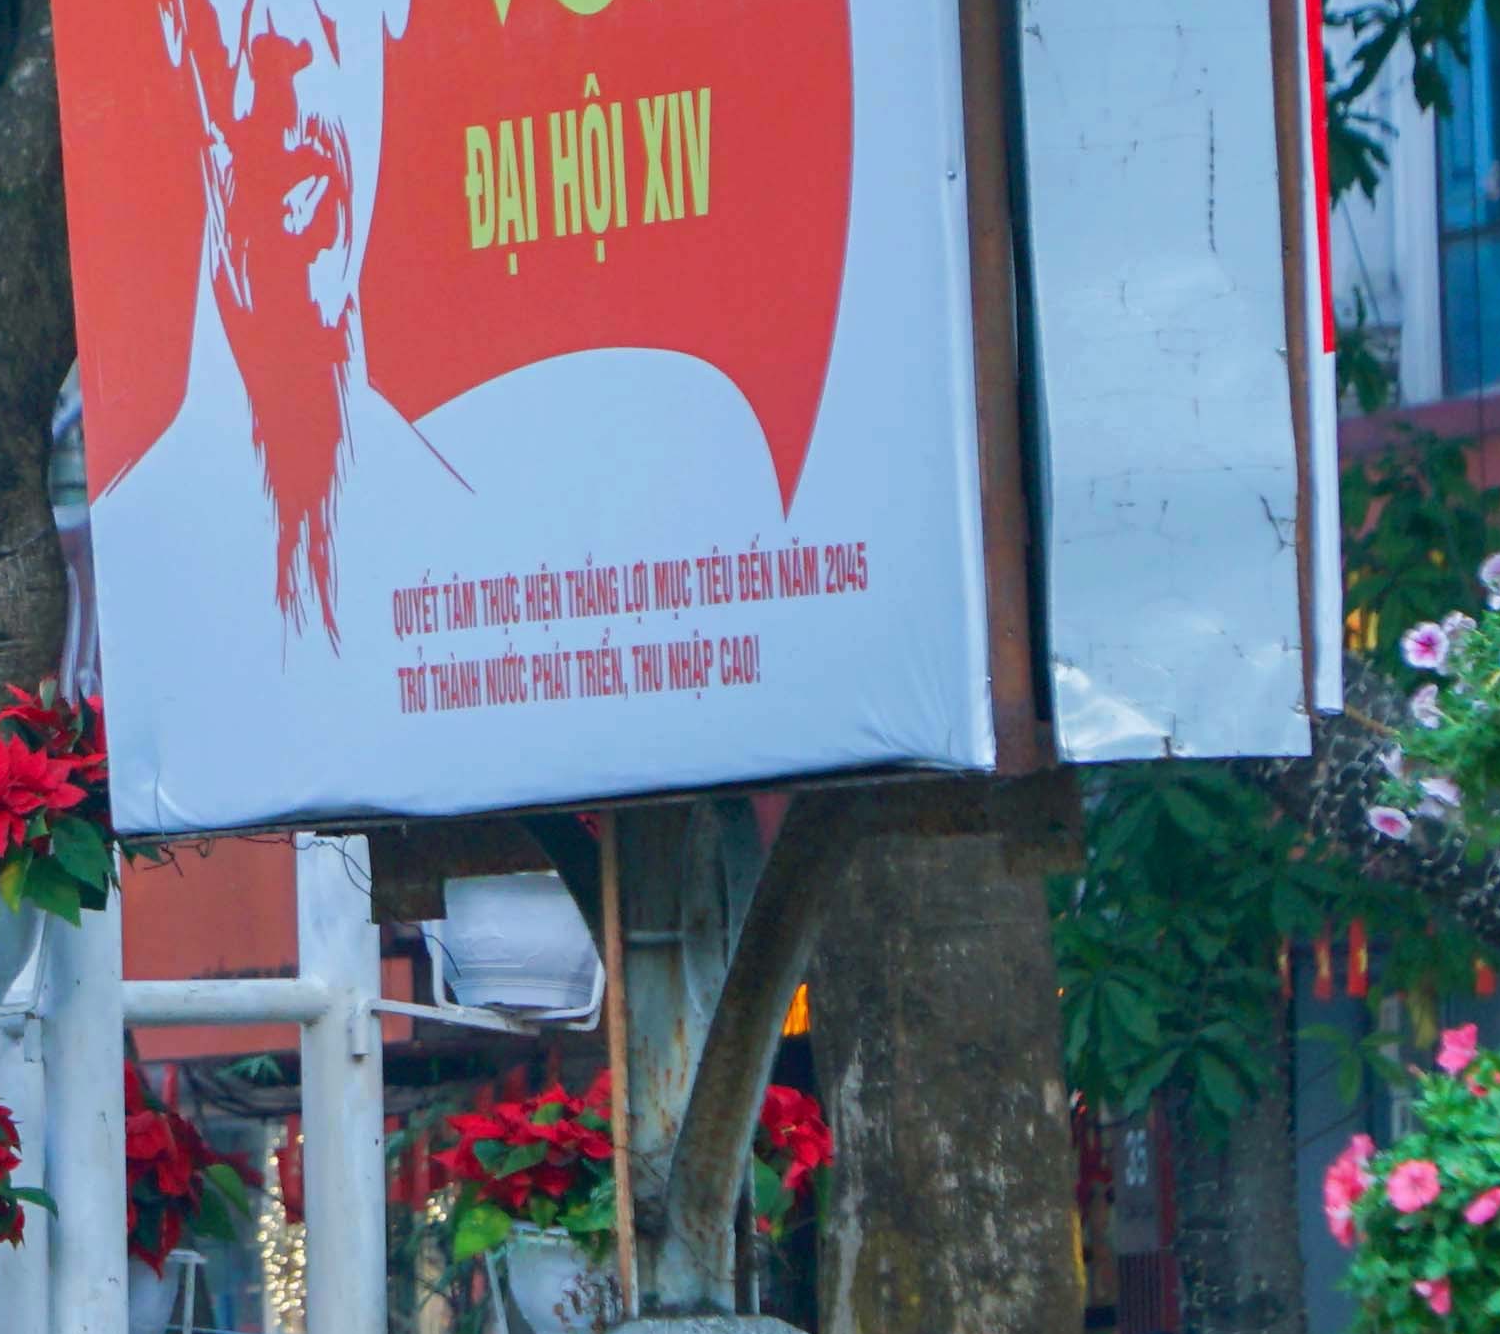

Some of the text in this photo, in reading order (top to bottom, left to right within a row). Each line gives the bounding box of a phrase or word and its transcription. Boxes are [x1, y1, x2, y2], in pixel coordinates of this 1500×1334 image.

[464, 71, 711, 276] ĐẠI HỘI XIV
[392, 533, 869, 642] QUYẾT TÂM THỰC HIỆN THẮNG LỢI MỤC TIÊU ĐẾN NĂM 2045
[397, 626, 761, 714] TRỞ THÀNH NƯỚC PHÁT TRIỂN, THU NHẬP CAO!
